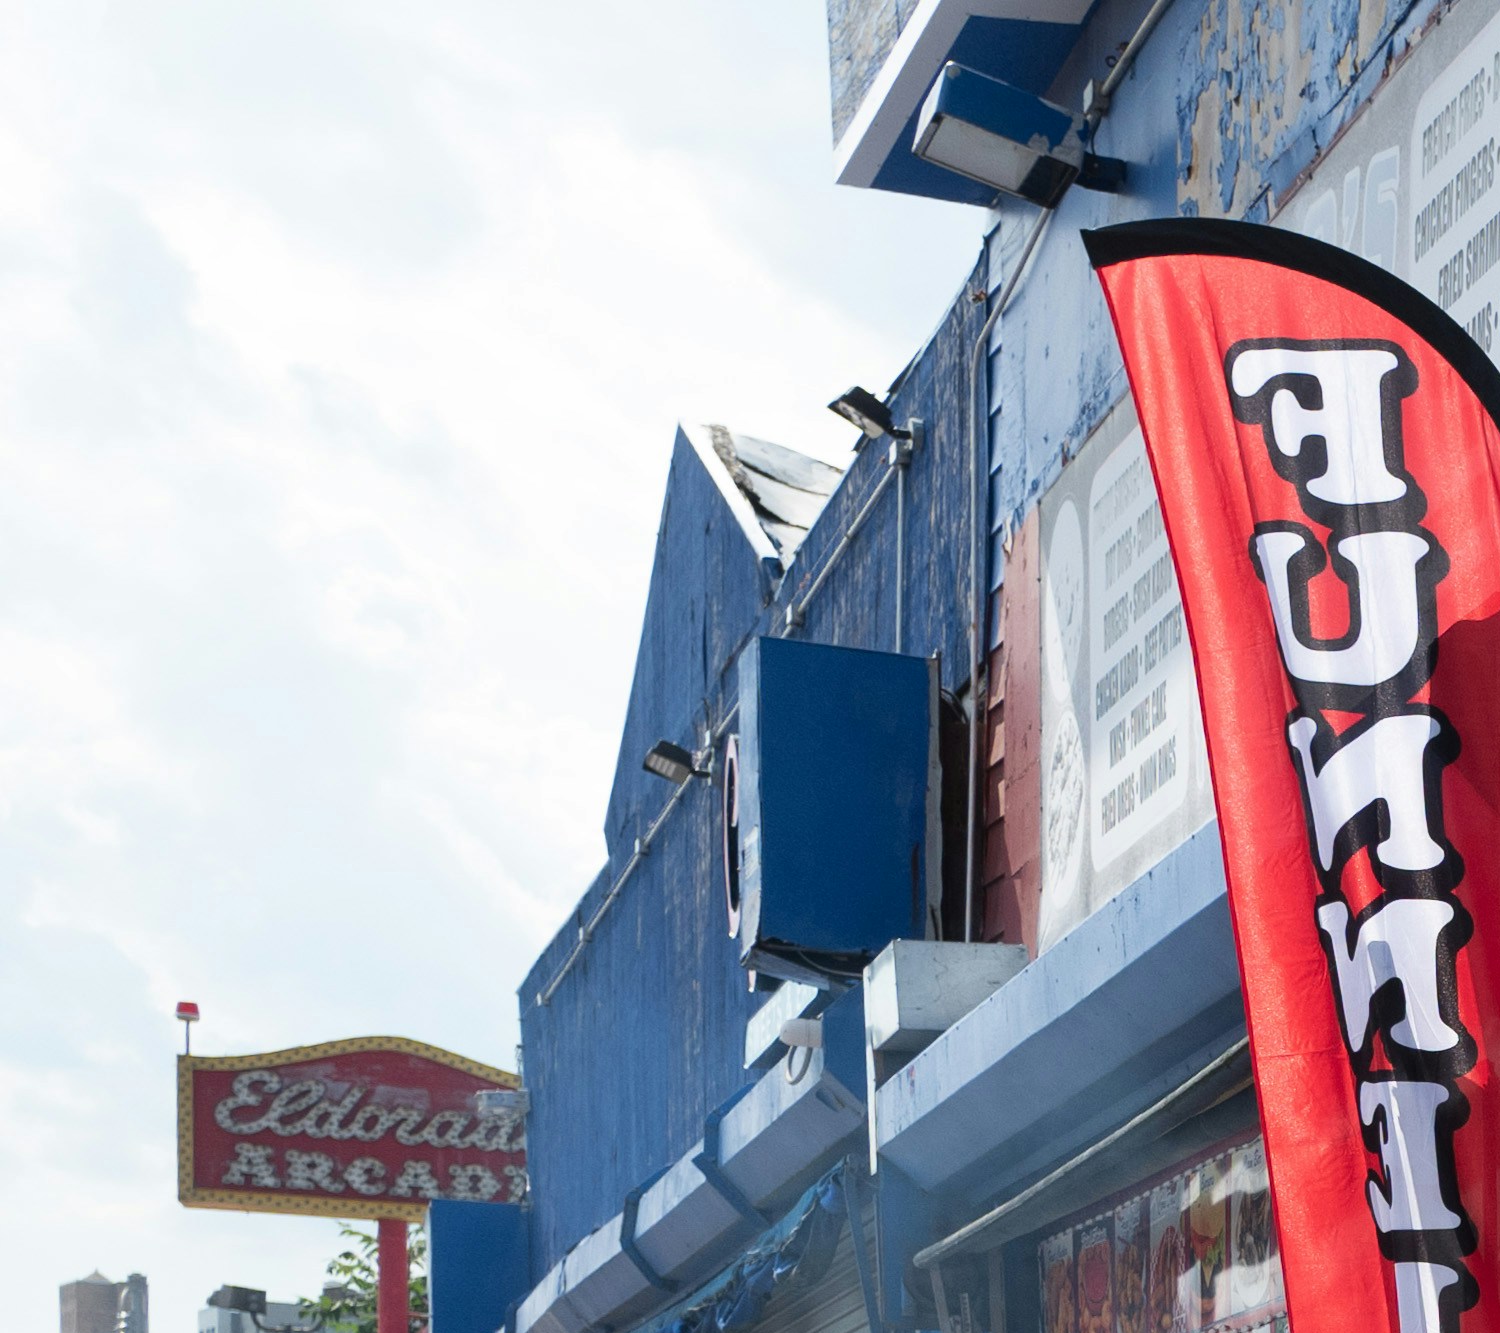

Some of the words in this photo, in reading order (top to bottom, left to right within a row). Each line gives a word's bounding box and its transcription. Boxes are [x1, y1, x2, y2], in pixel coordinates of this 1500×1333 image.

[1459, 67, 1485, 138] FRIES
[1414, 178, 1453, 263] CHICKEN
[1455, 137, 1495, 221] FINGERS
[1438, 244, 1464, 311] FRIED
[215, 1070, 527, 1153] Eldorad
